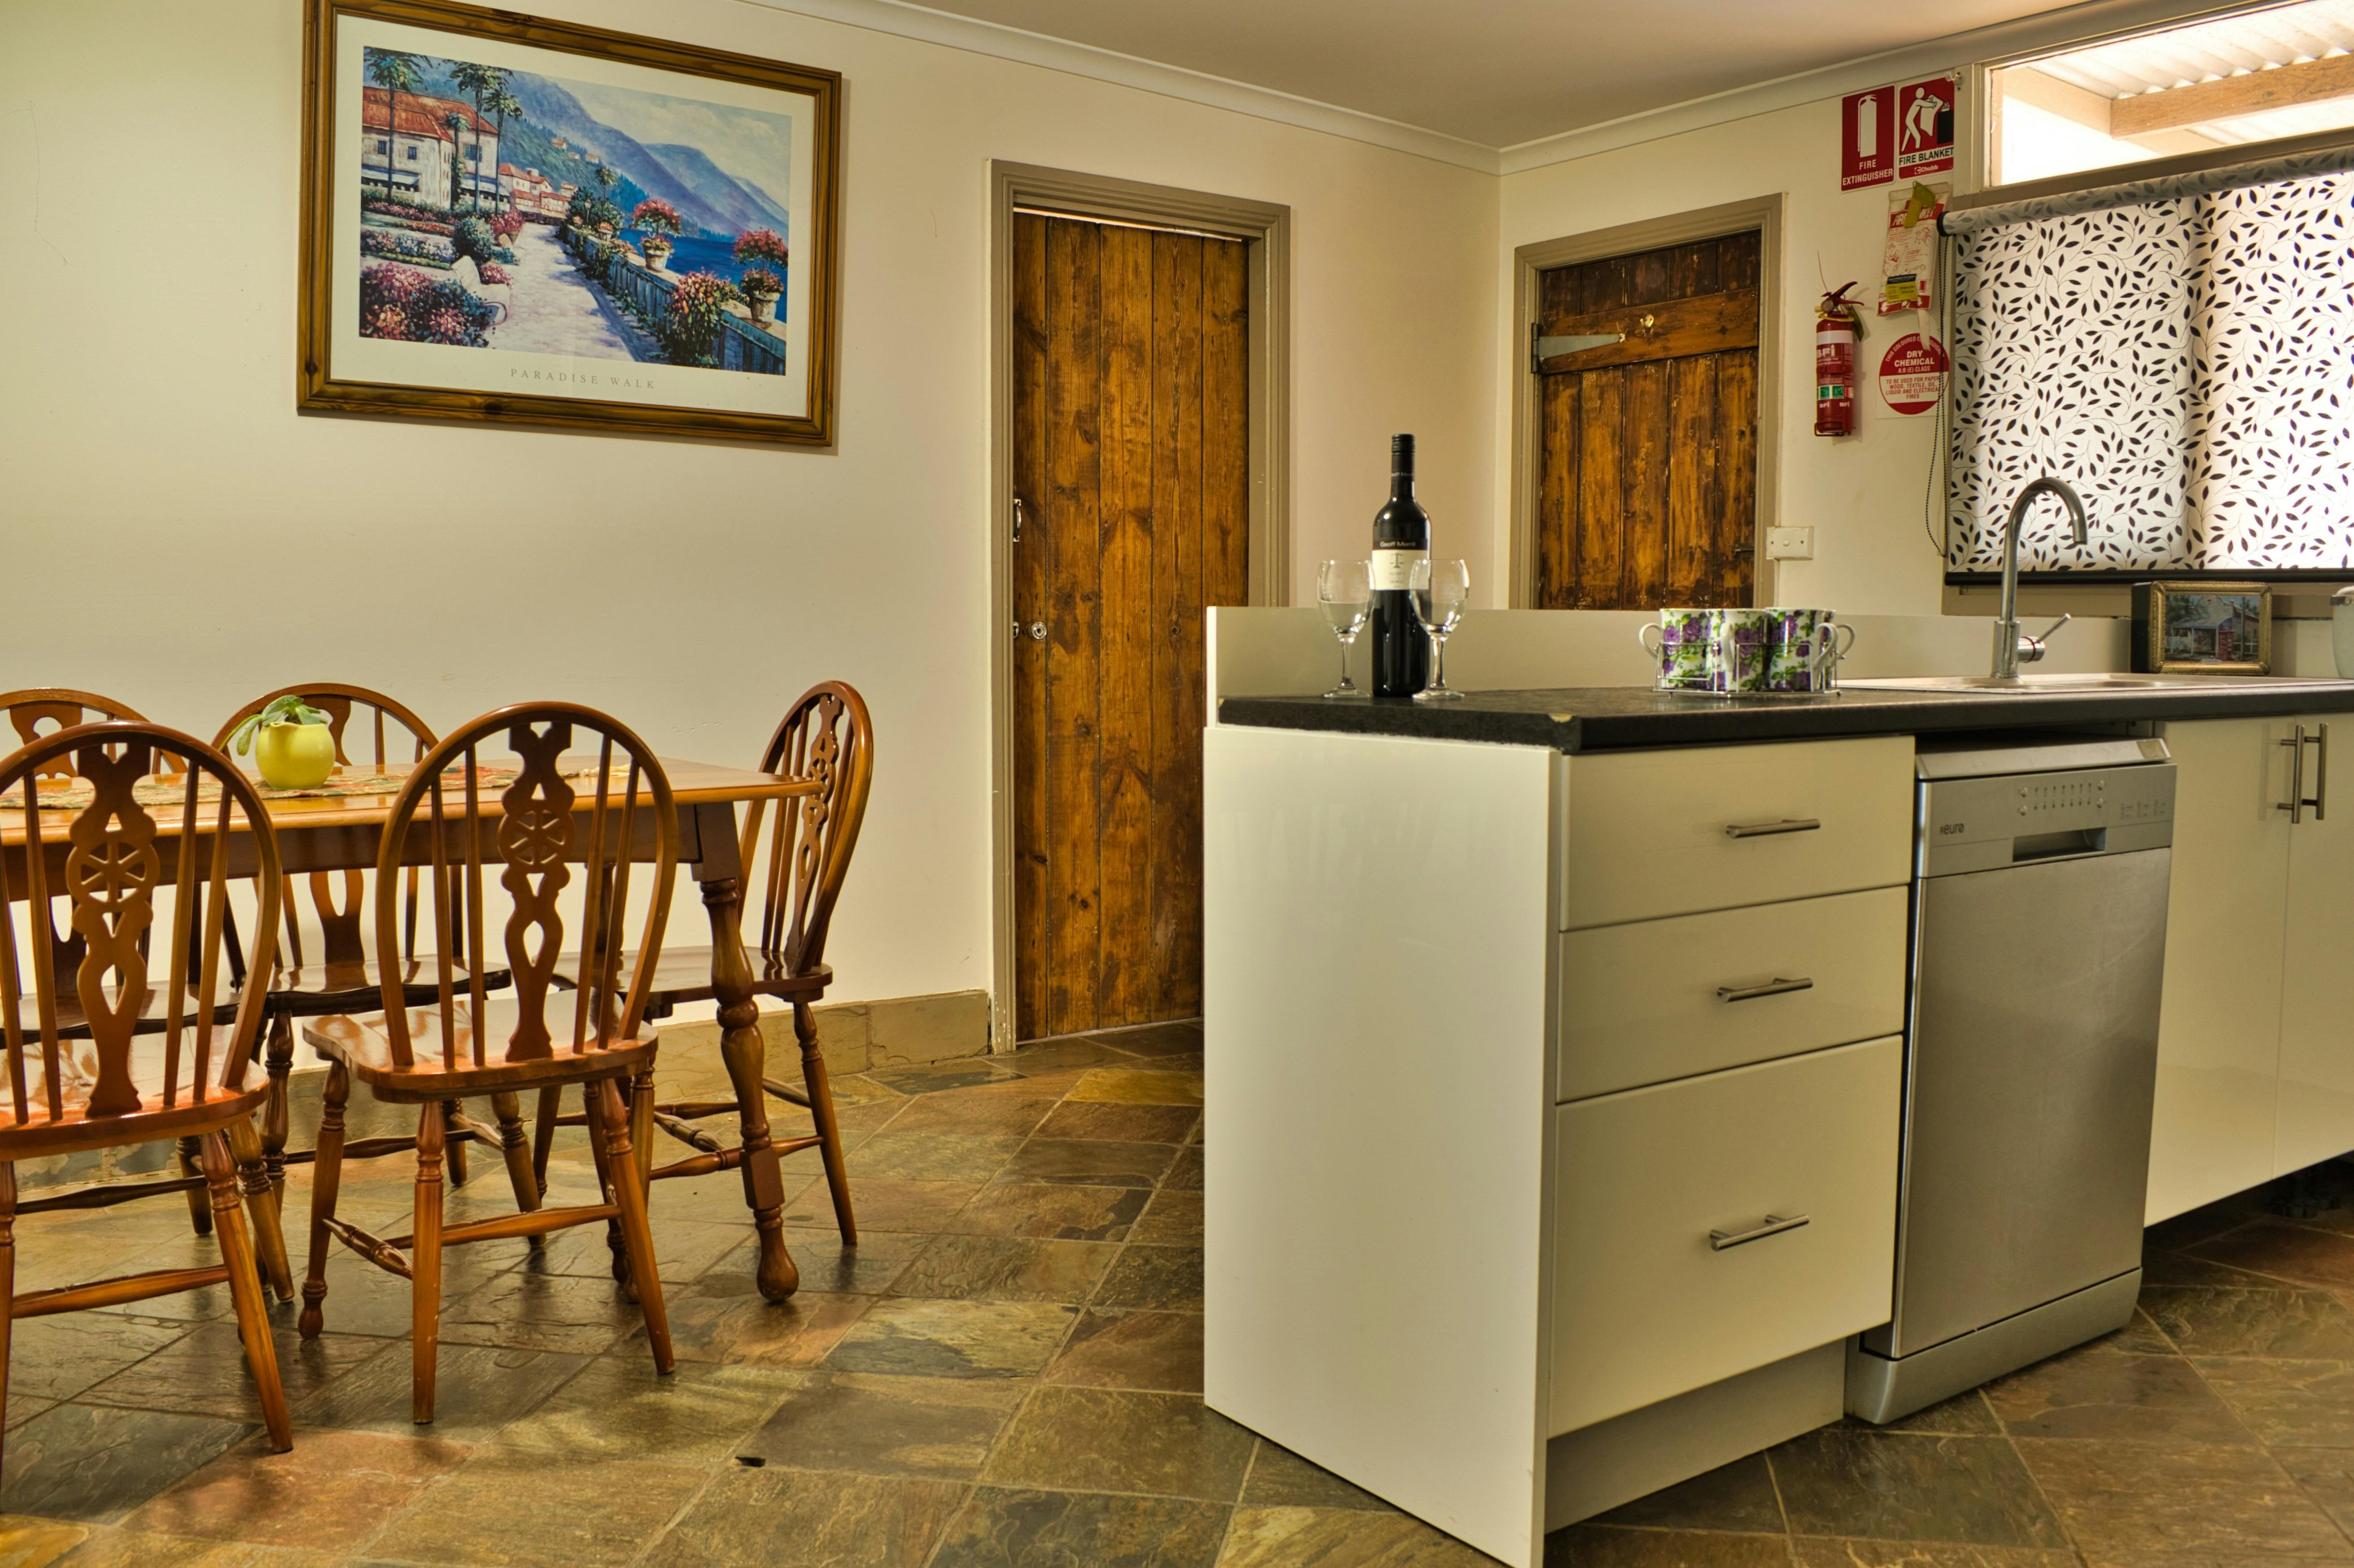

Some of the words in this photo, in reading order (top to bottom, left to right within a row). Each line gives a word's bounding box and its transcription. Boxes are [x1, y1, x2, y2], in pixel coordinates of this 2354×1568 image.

[1899, 154, 1917, 166] FIRE
[1918, 147, 1954, 161] BLANKET
[1859, 160, 1876, 170] FIRE
[1921, 165, 1939, 173] Chubb
[1843, 168, 1893, 186] EXTINGUISHER
[1885, 350, 1894, 362] THIS
[1893, 337, 1916, 351] COLOURED
[1907, 350, 1923, 358] DRY
[1894, 358, 1935, 367] CHEMICAL
[511, 369, 598, 384] PARADISE
[610, 377, 654, 389] WALK
